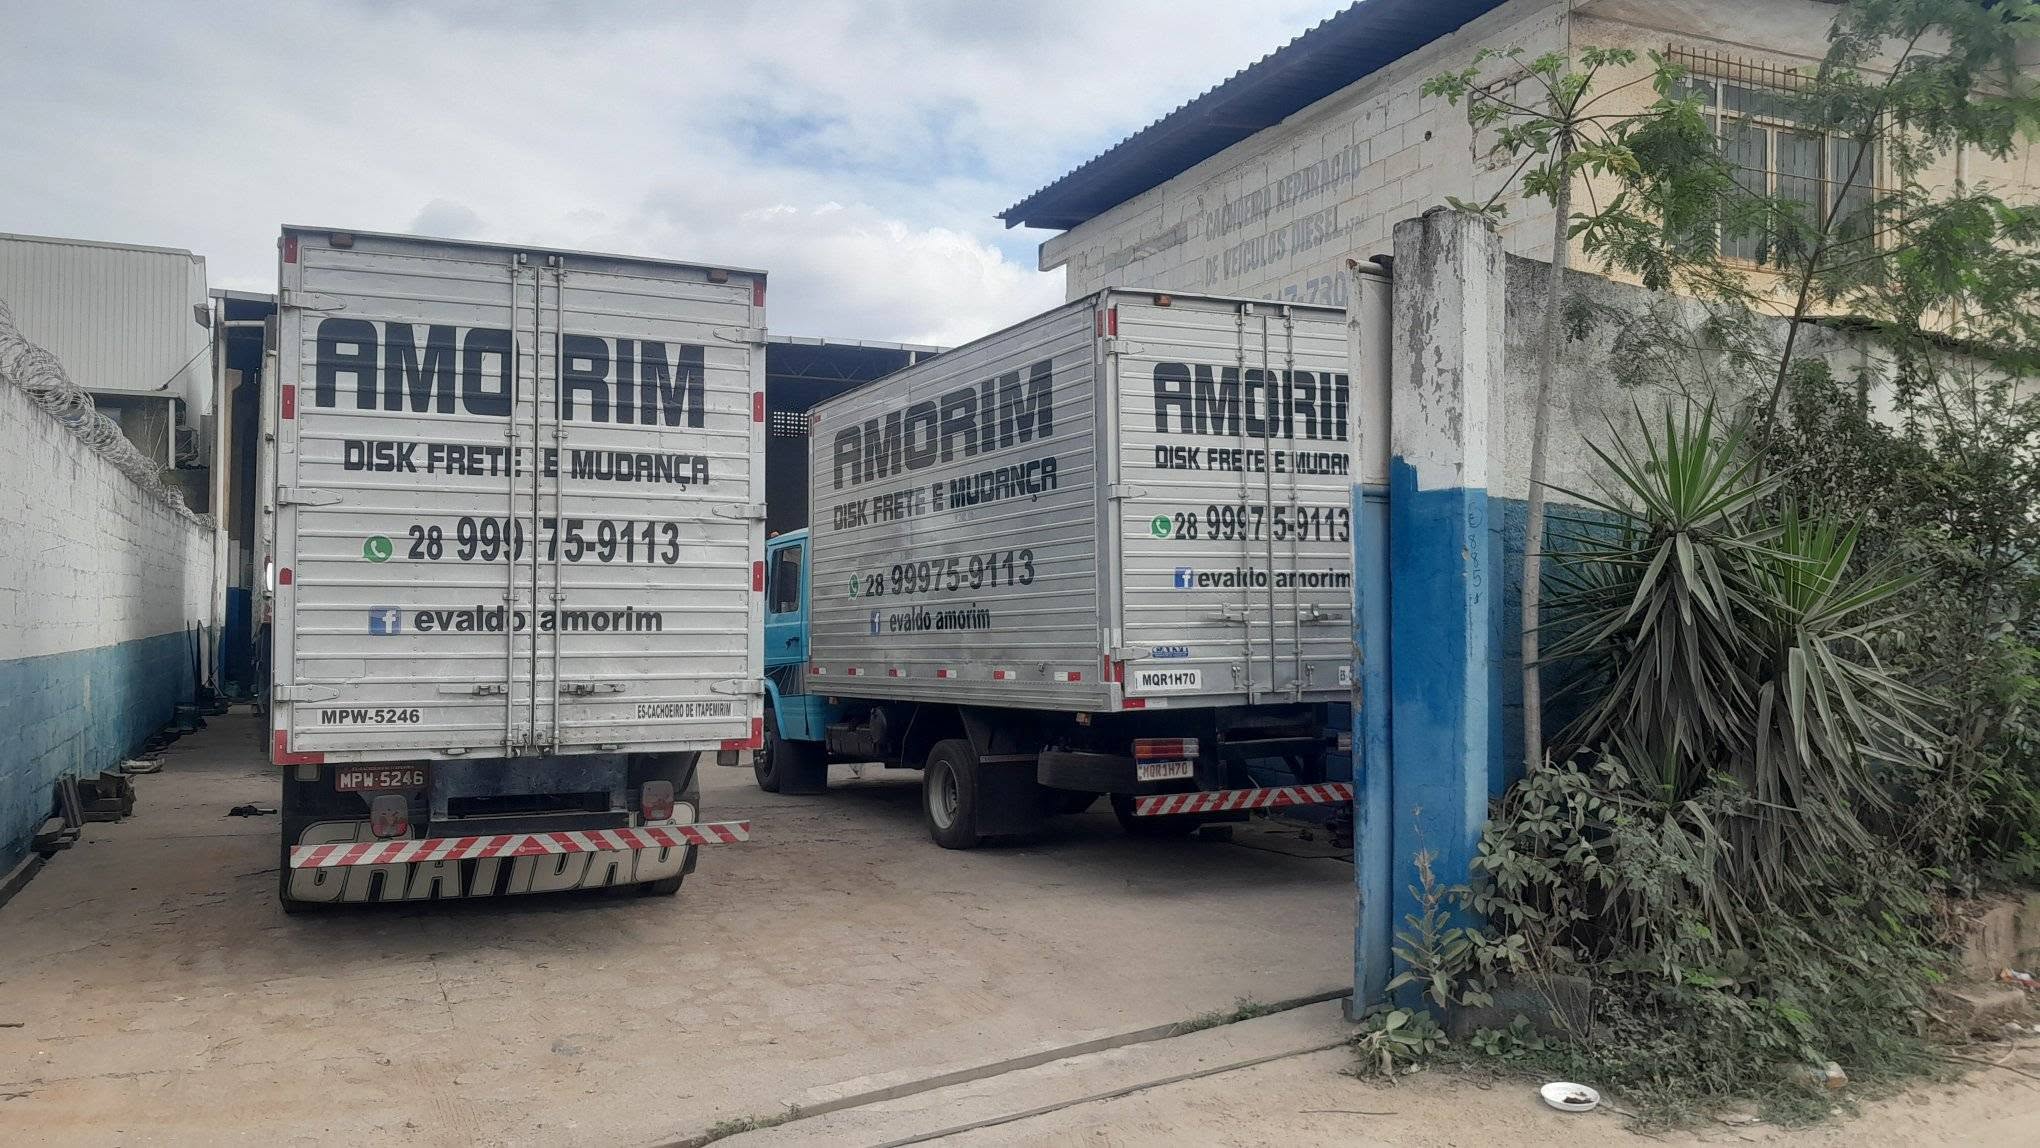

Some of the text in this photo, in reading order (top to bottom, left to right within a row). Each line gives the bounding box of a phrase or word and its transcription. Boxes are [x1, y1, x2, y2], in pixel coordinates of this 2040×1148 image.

[316, 317, 704, 428] AMORIM
[834, 359, 1053, 489] AMORIM
[344, 440, 709, 491] DISK FRETE E MUDANÇA
[1155, 445, 1201, 470] DISK
[1207, 448, 1265, 472] FRETE
[1275, 450, 1286, 473] E
[834, 456, 1057, 531] DISK FRETE E MUDANÇA
[1174, 512, 1198, 539] 28
[408, 525, 443, 560] 28
[866, 549, 1035, 597] 28 99975-9113
[1198, 567, 1267, 588] evaldo
[414, 605, 525, 633] evaldo
[541, 605, 662, 632] amorim
[890, 605, 931, 632] evaldo
[936, 602, 991, 630] amorim
[1142, 673, 1196, 686] MQR1H70
[321, 709, 420, 725] MPW-5246
[637, 703, 684, 719] ES-CACHOEIRO
[686, 703, 694, 717] DE
[1143, 763, 1188, 778] MQR1H70
